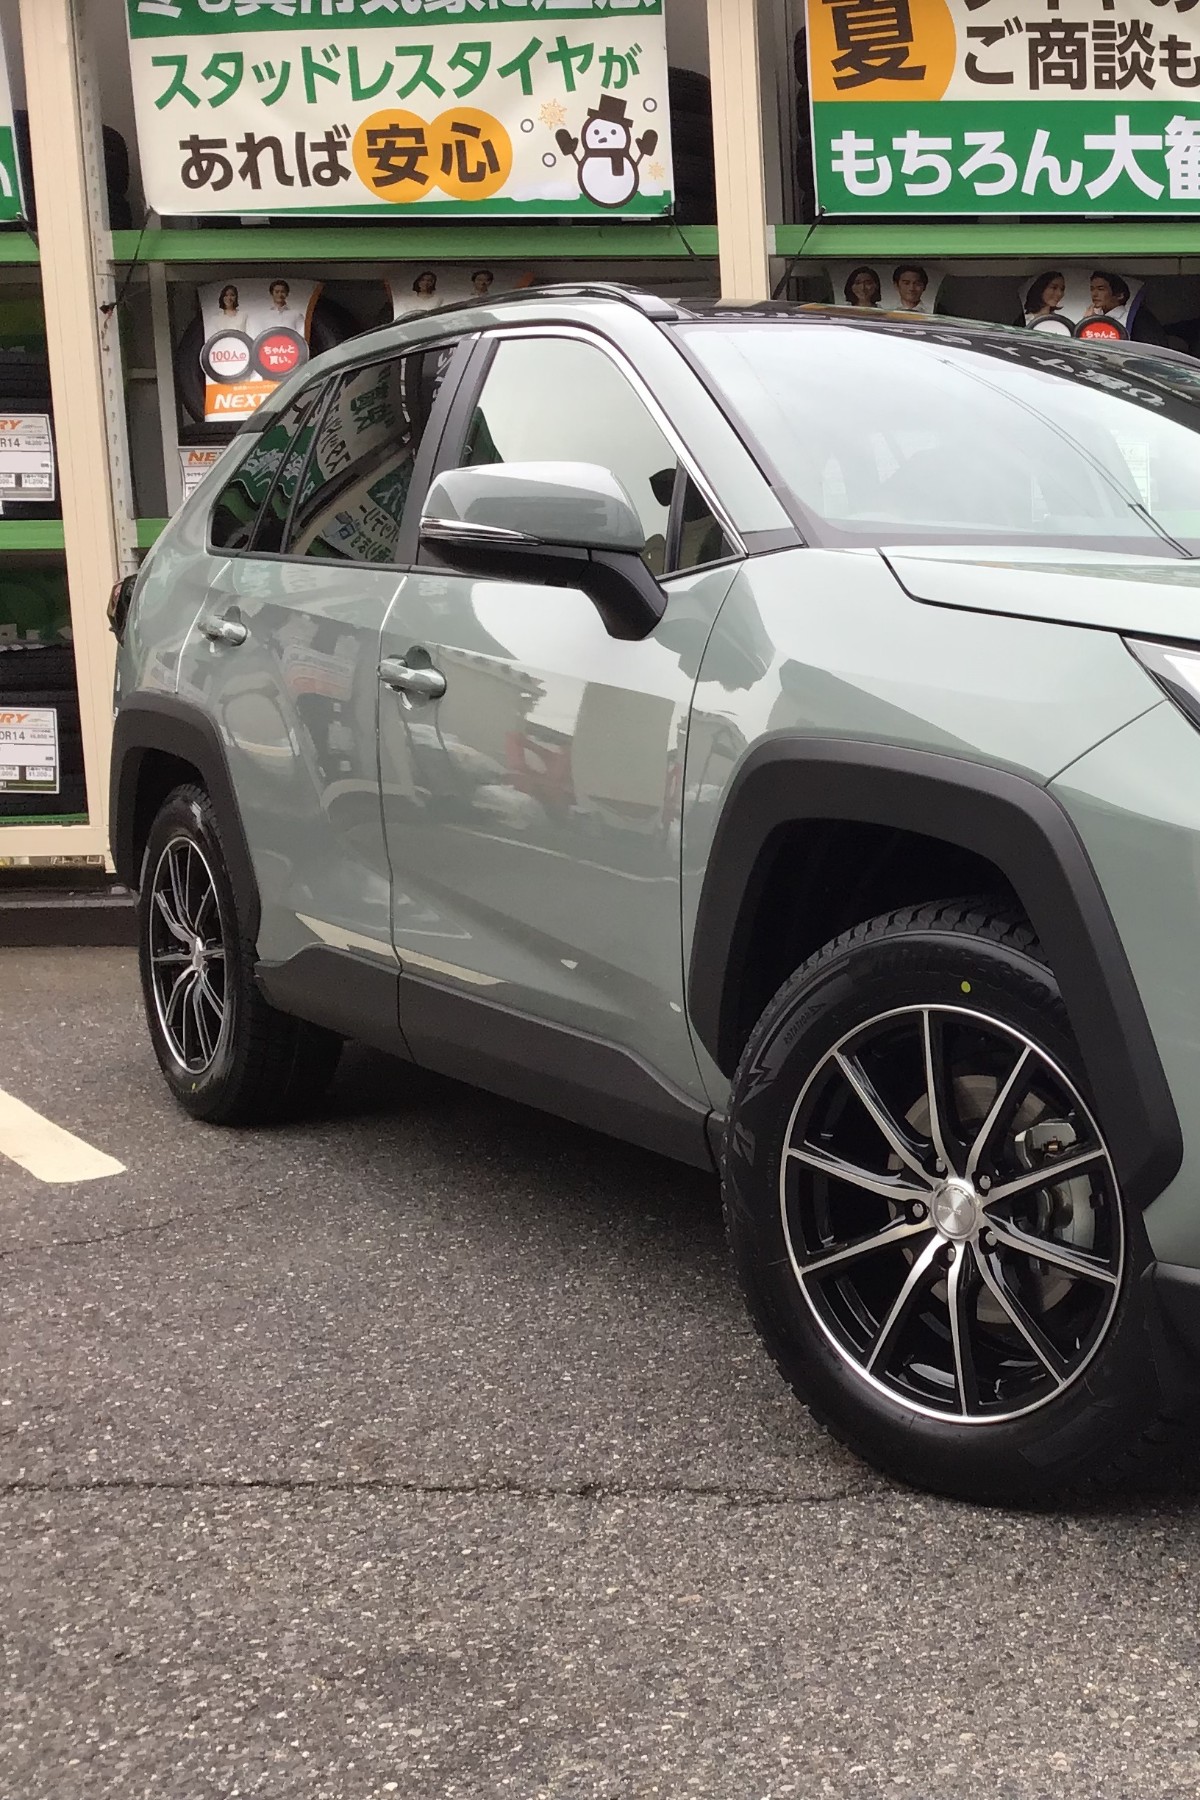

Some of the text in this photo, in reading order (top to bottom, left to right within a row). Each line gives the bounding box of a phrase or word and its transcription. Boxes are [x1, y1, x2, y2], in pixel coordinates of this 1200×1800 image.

[830, 0, 927, 91] 夏
[150, 35, 643, 111] スタッドレスタイヤが
[179, 121, 502, 190] あれば安心
[211, 350, 247, 362] 100人の
[263, 344, 295, 355] ちゃんと
[188, 451, 218, 462] NE
